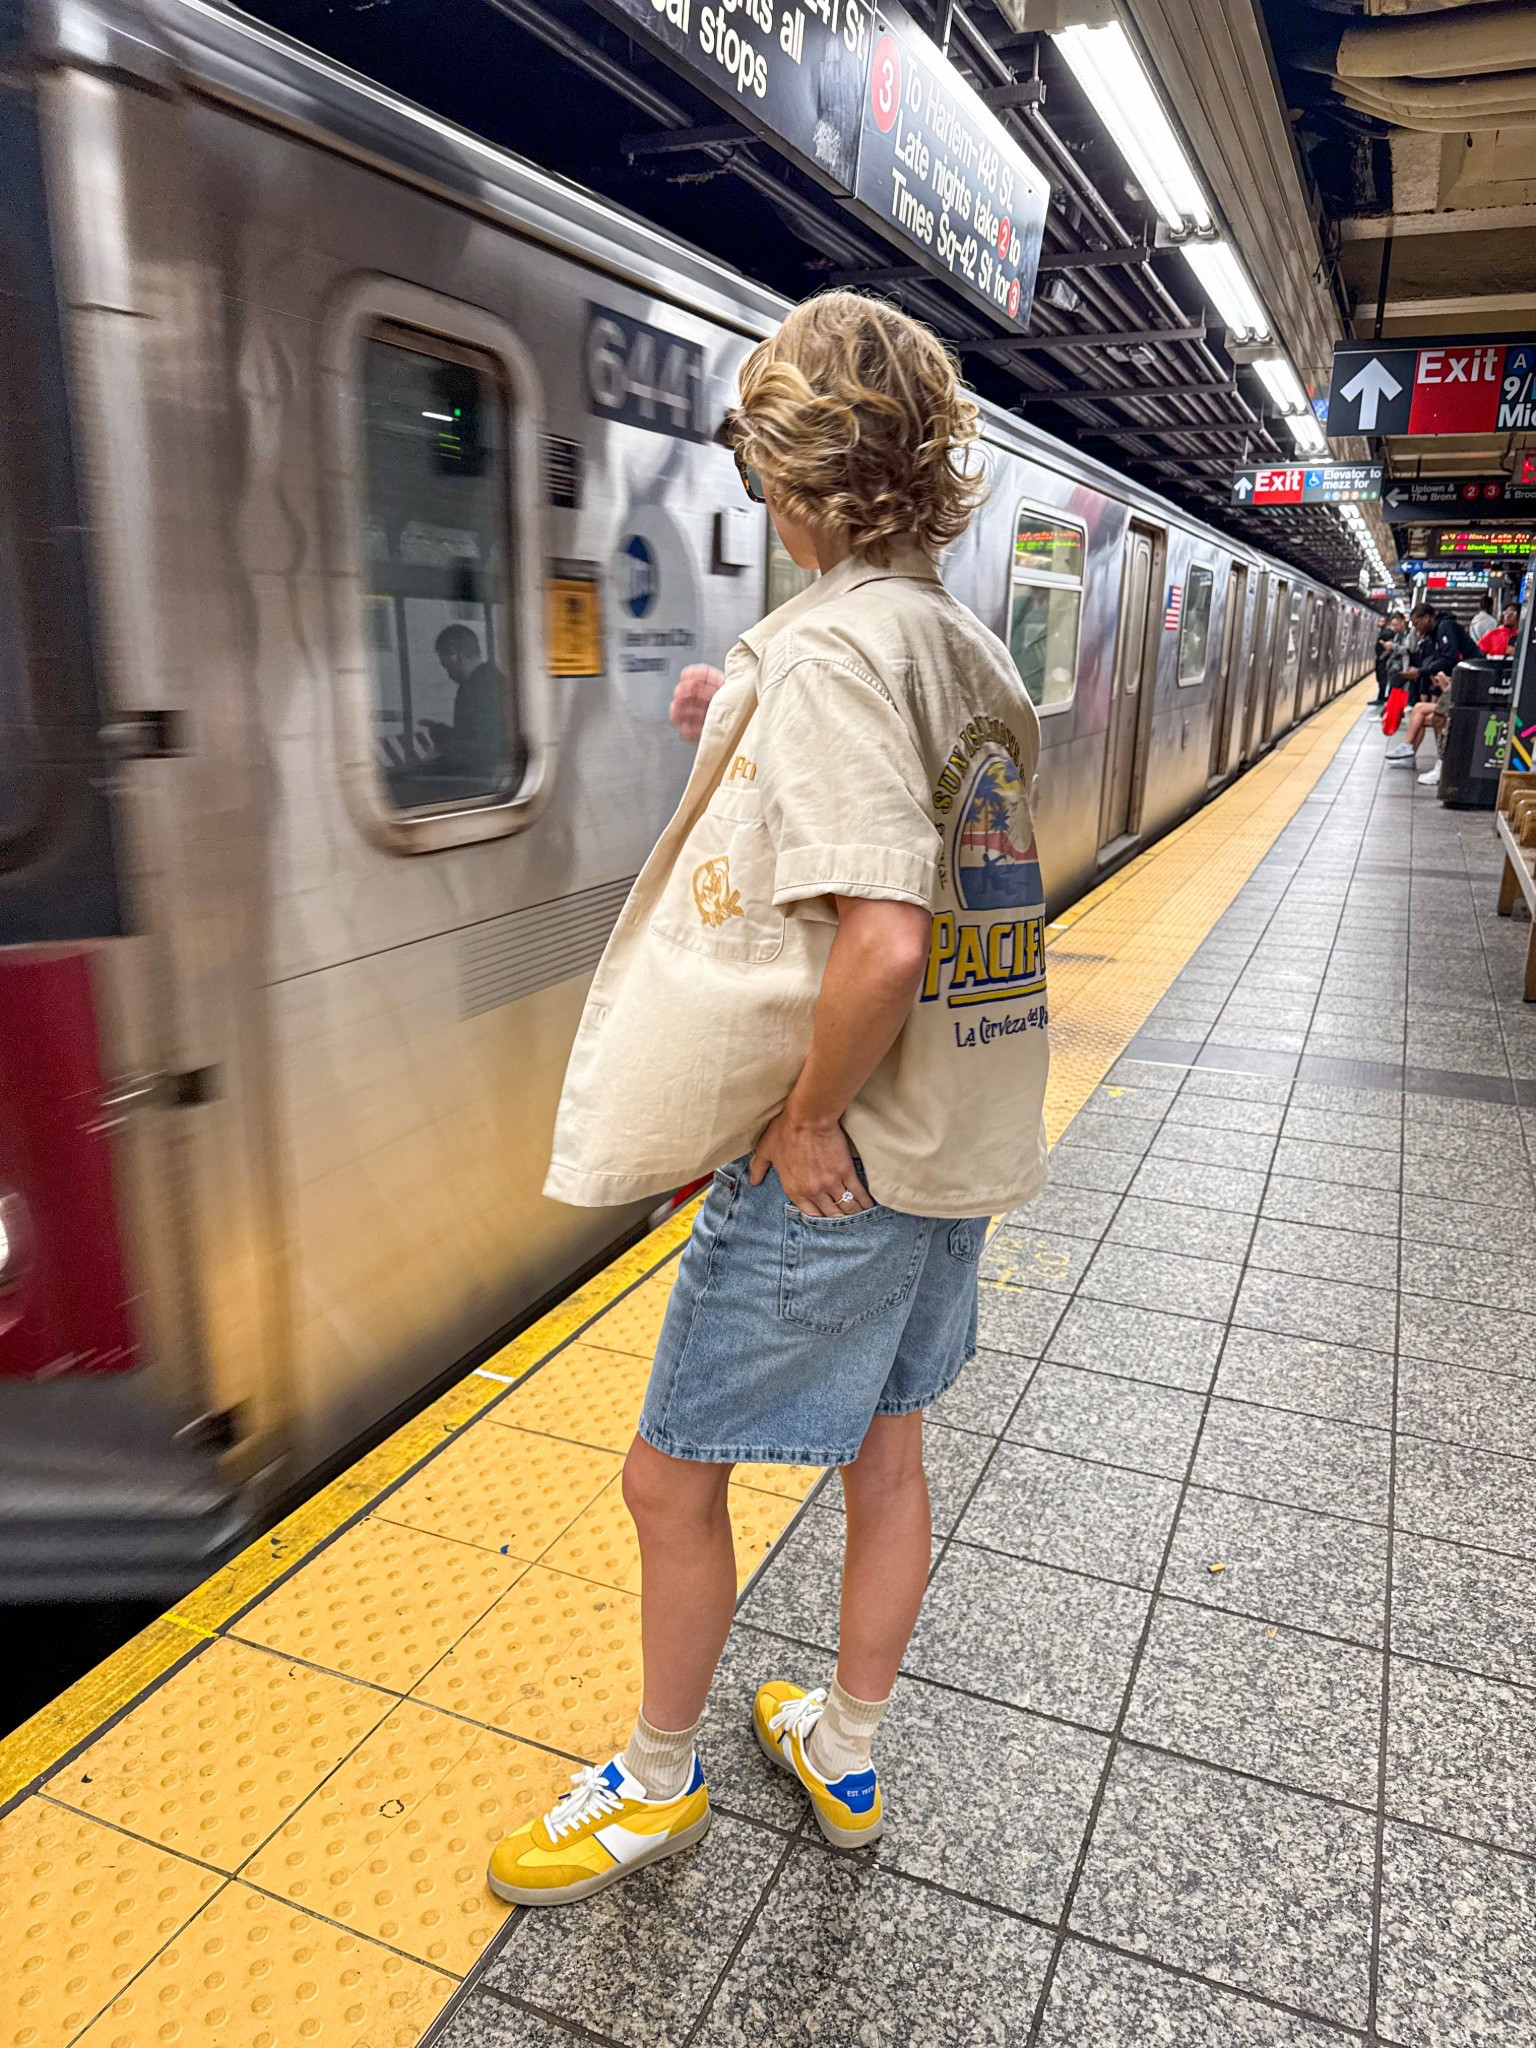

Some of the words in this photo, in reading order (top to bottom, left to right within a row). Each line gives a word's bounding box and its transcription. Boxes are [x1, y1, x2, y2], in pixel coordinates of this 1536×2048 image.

[700, 6, 768, 98] stops
[780, 7, 805, 65] all
[843, 0, 865, 62] St
[879, 58, 894, 113] 3
[905, 54, 922, 114] To
[925, 80, 999, 193] Harlem-148
[1000, 164, 1014, 214] St
[894, 108, 929, 181] Late
[932, 154, 971, 221] nights
[973, 190, 999, 248] take
[1000, 226, 1009, 252] 2
[1009, 226, 1021, 268] to
[891, 166, 934, 246] Times
[937, 212, 978, 282] Sq-42
[978, 248, 994, 293] St
[994, 263, 1010, 307] for
[1417, 347, 1499, 384] Exit
[1513, 353, 1527, 369] A
[1254, 471, 1301, 492] Exit
[1322, 480, 1351, 490] mezz
[1354, 479, 1370, 488] for
[1323, 470, 1367, 480] Elevator
[1370, 469, 1382, 478] to
[1410, 493, 1428, 501] The
[1430, 493, 1457, 501] Bronx
[1411, 484, 1445, 494] Uptown
[933, 744, 970, 815] SUN
[954, 1022, 976, 1048] La
[980, 1013, 1026, 1045] Cerveza
